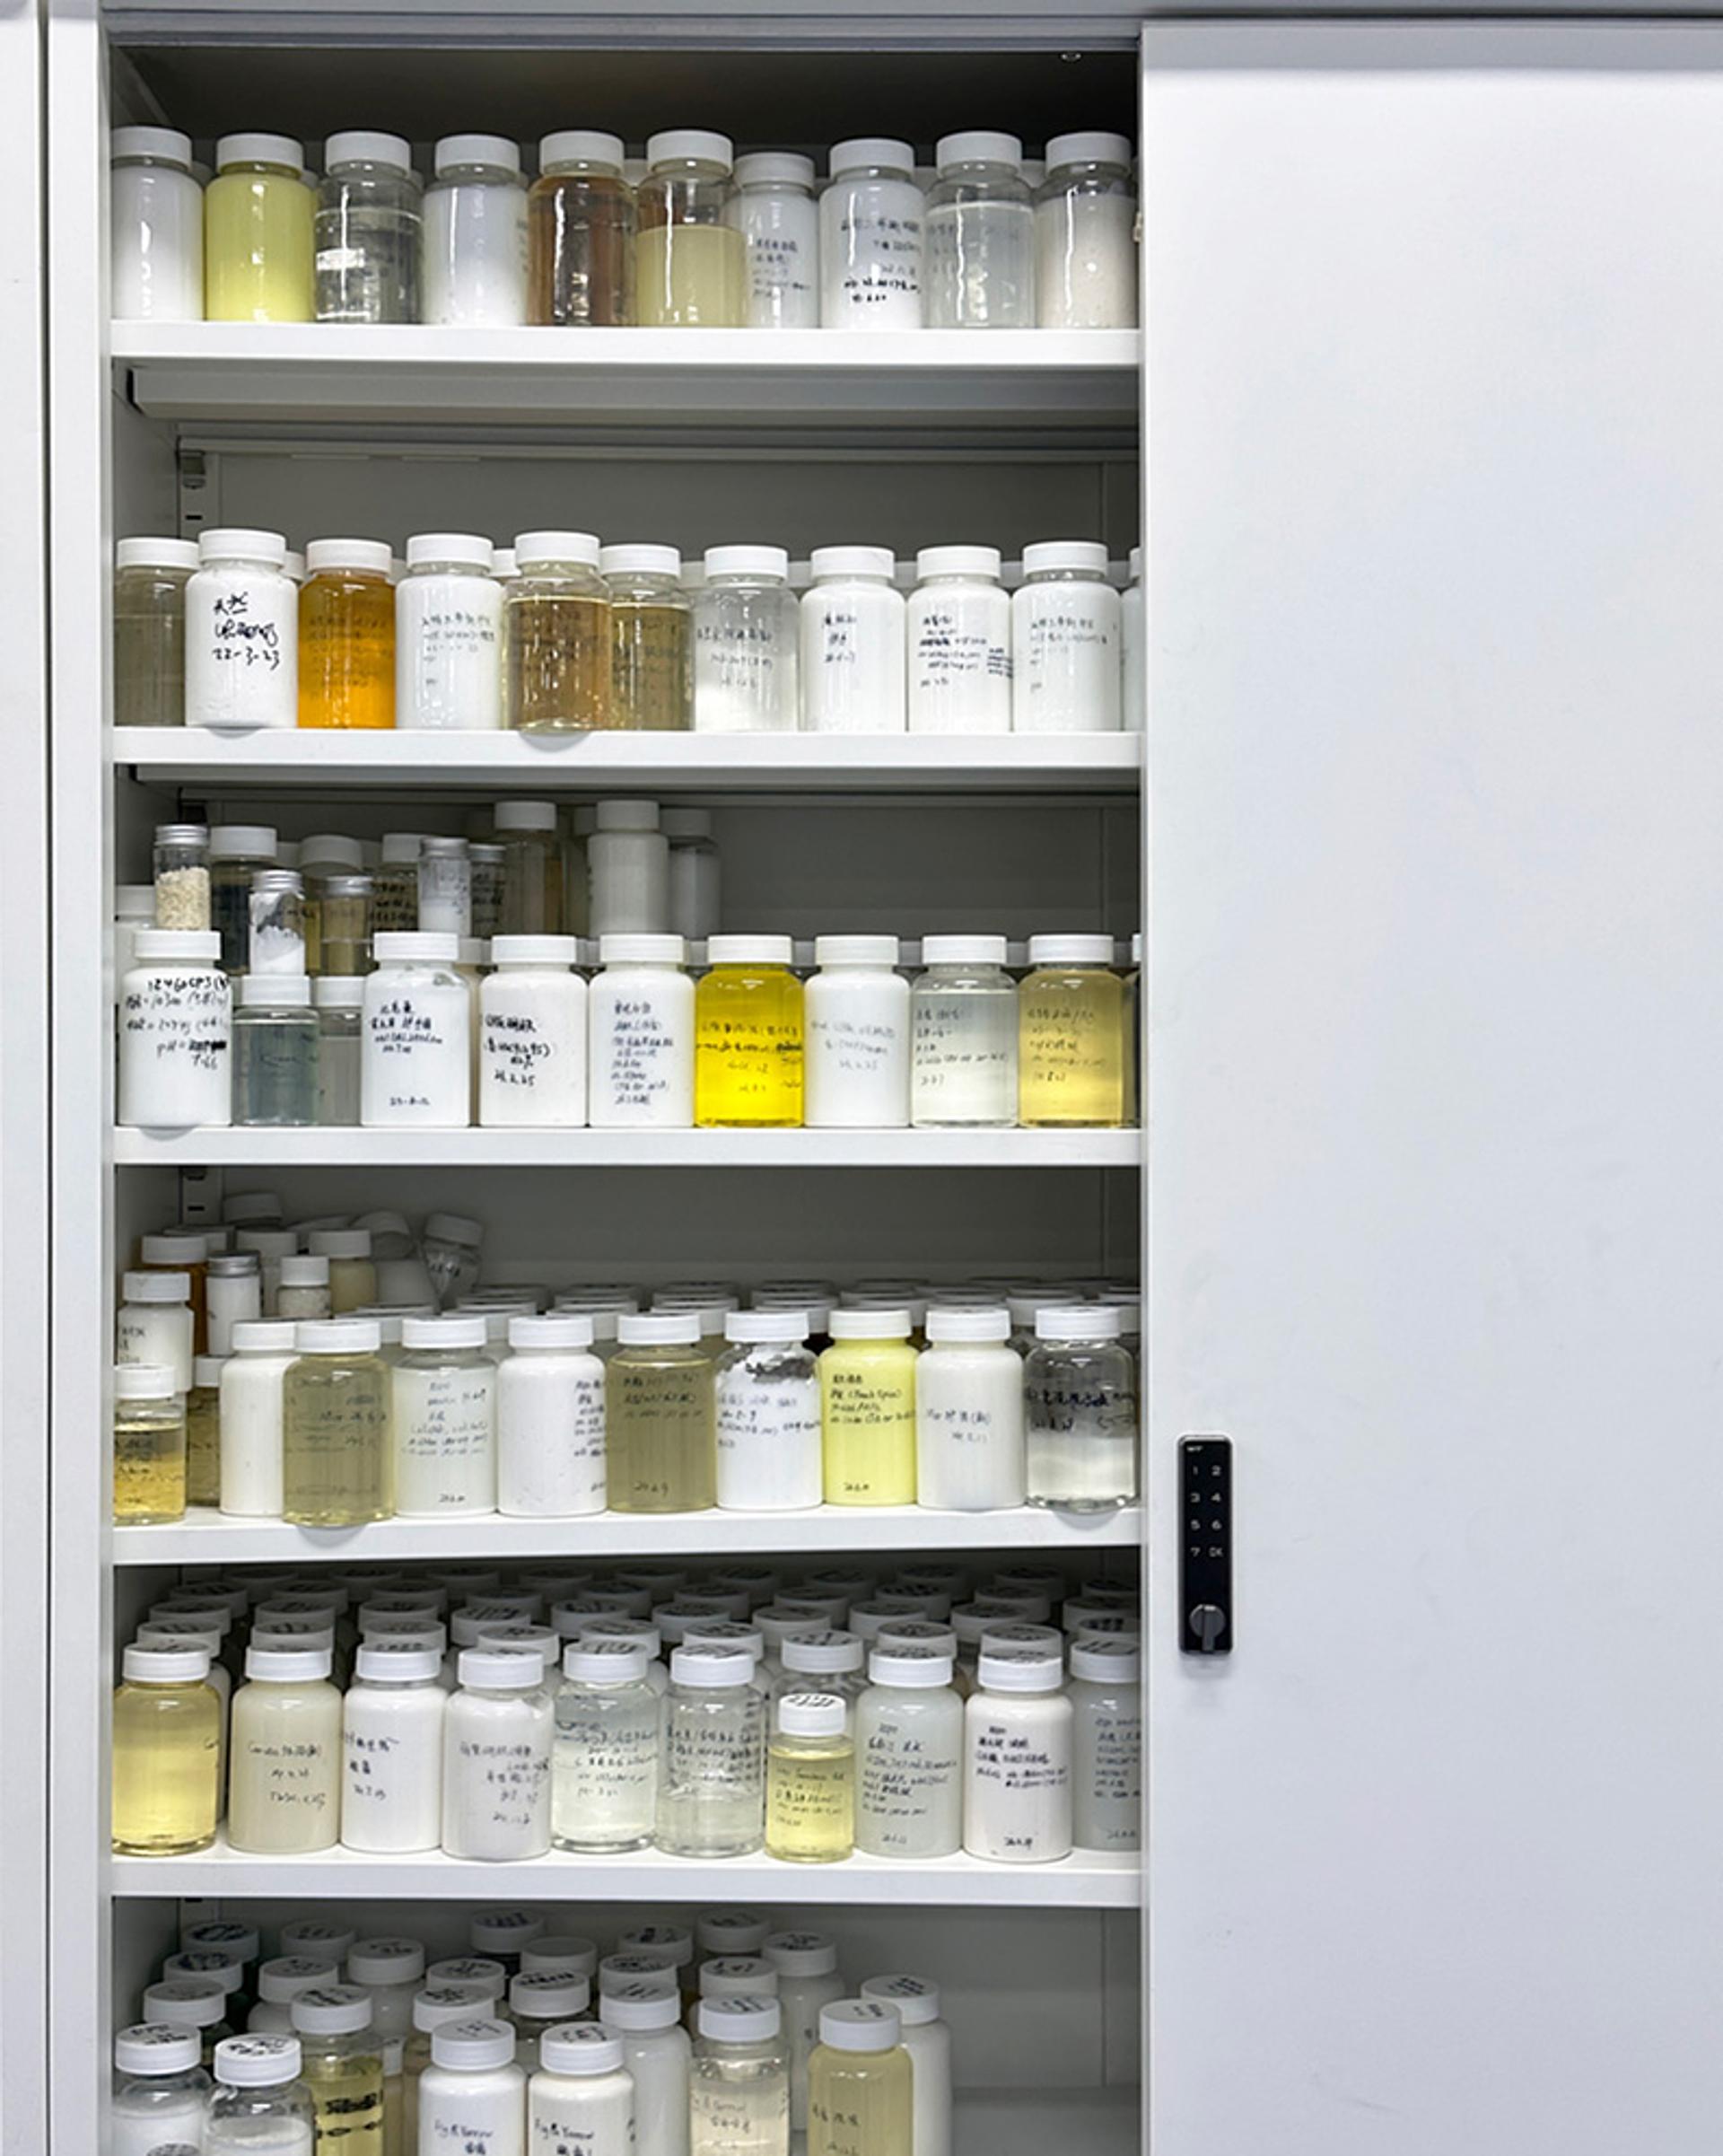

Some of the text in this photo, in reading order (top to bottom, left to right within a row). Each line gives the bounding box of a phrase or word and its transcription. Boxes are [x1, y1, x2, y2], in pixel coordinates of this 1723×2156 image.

[1192, 1465, 1221, 1477] 1 2
[1190, 1493, 1221, 1503] 3 4
[1190, 1520, 1221, 1530] 5 6
[1190, 1547, 1201, 1557] 7
